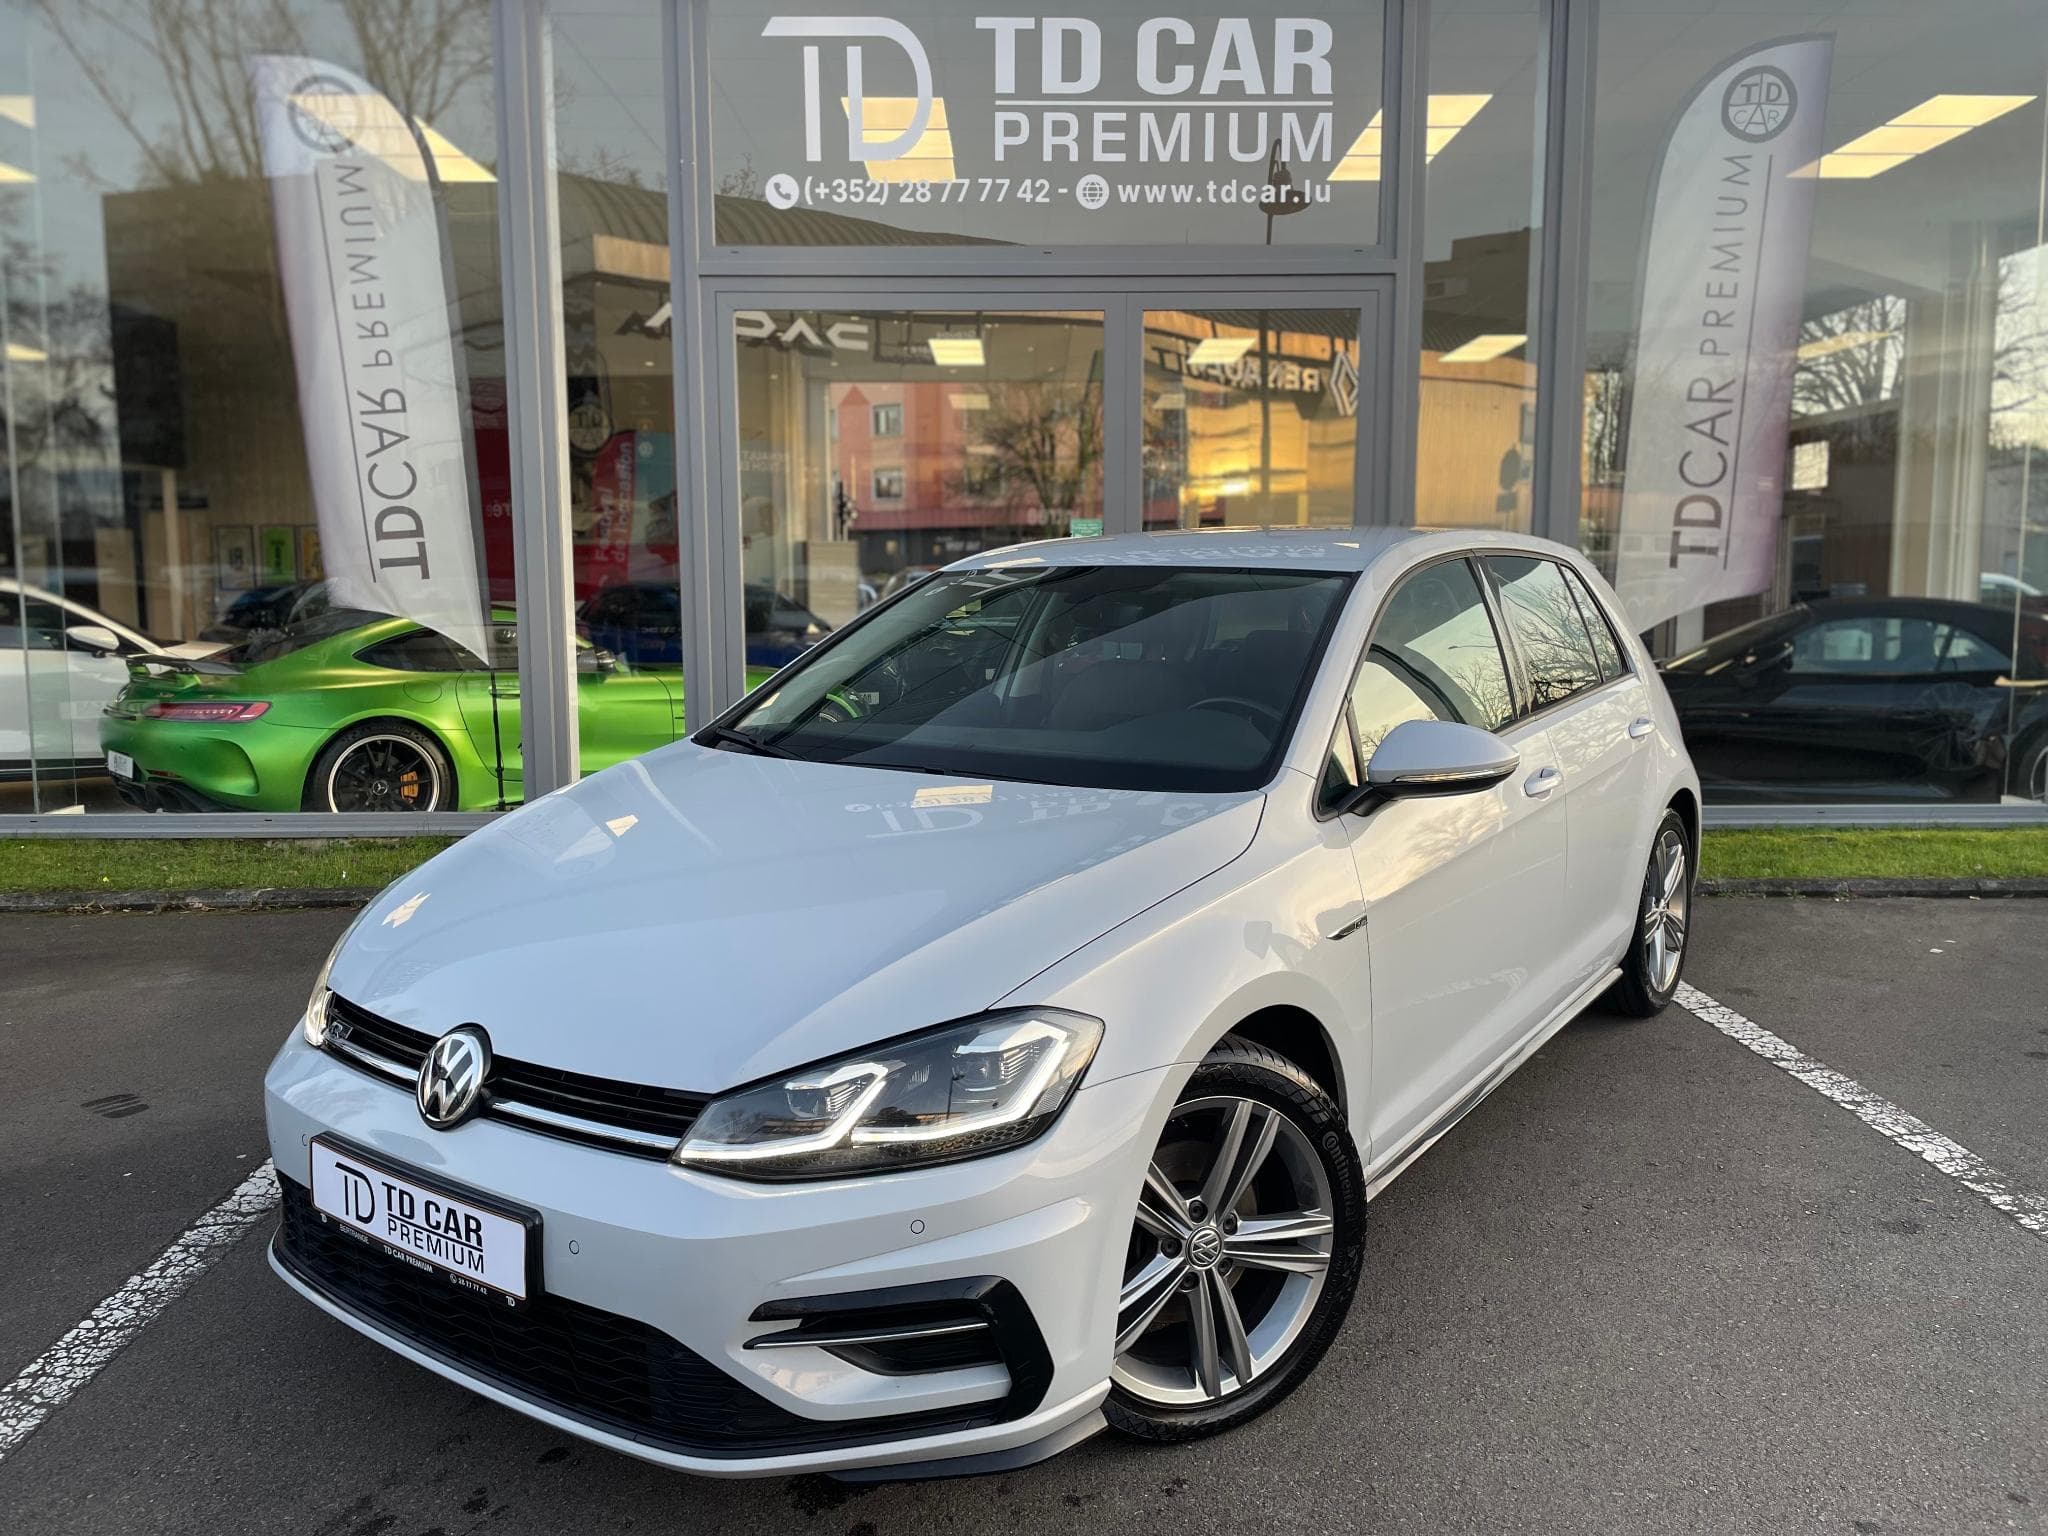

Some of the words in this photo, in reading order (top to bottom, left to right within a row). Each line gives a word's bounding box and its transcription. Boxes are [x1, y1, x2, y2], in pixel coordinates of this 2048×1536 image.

[975, 17, 1101, 94] TD
[1136, 17, 1334, 95] CAR
[1741, 82, 1783, 103] TD
[994, 111, 1334, 162] PREMIUM
[804, 177, 890, 206] (+352)
[899, 178, 932, 204] 28
[940, 178, 971, 204] 77
[978, 178, 1011, 204] 77
[1016, 178, 1051, 204] 42
[1117, 178, 1332, 204] www.tdcar.lu
[1699, 154, 1753, 357] PREMIUM
[1669, 376, 1736, 570] TDCAR
[381, 1181, 415, 1220] TD
[424, 1199, 483, 1248] CAR
[383, 1244, 393, 1255] TD
[392, 1249, 405, 1260] CAR
[405, 1255, 434, 1274] PREMIUM
[387, 1217, 485, 1274] PREMIUM
